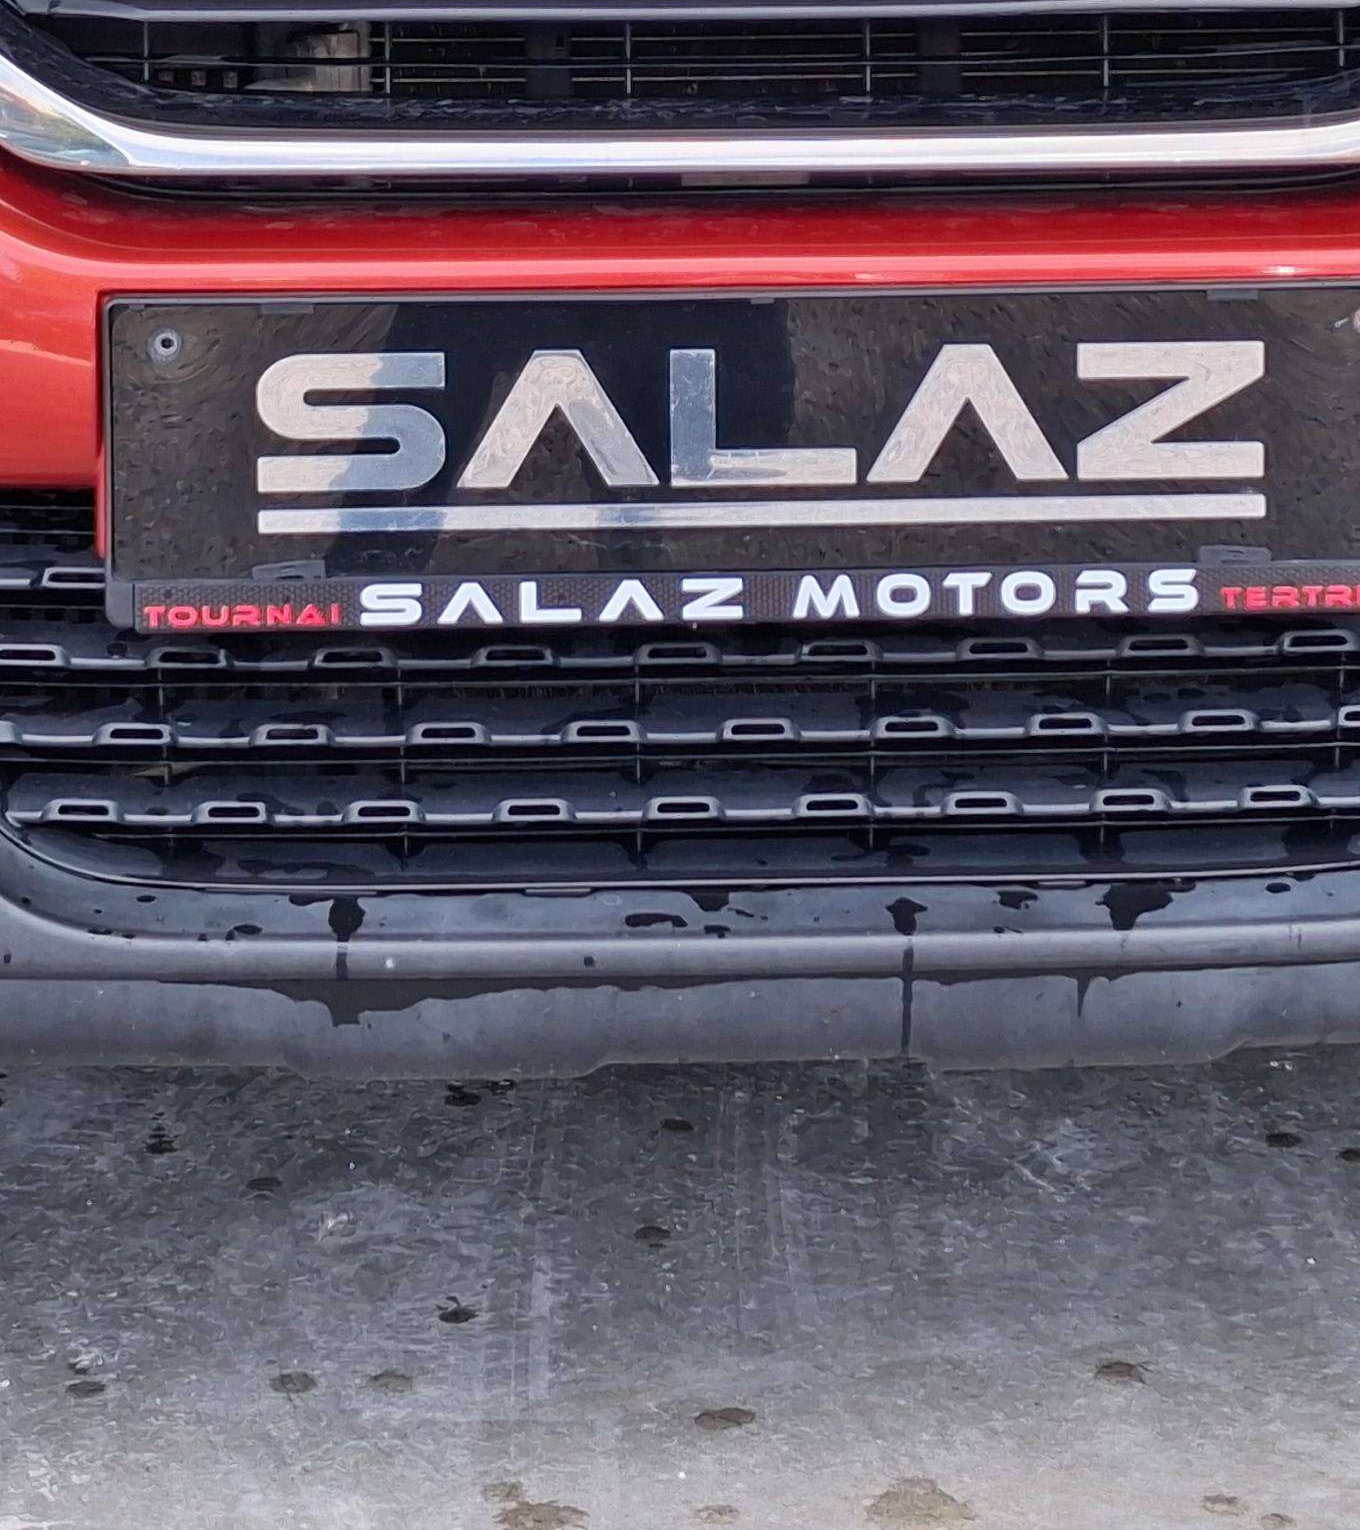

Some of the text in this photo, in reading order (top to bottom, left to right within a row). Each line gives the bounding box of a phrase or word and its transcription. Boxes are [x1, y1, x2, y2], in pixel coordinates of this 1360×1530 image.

[256, 341, 1267, 492] SALAZ
[143, 602, 340, 630] TOURNAI
[359, 578, 745, 627] SALAZ
[791, 568, 1199, 619] MOTORS
